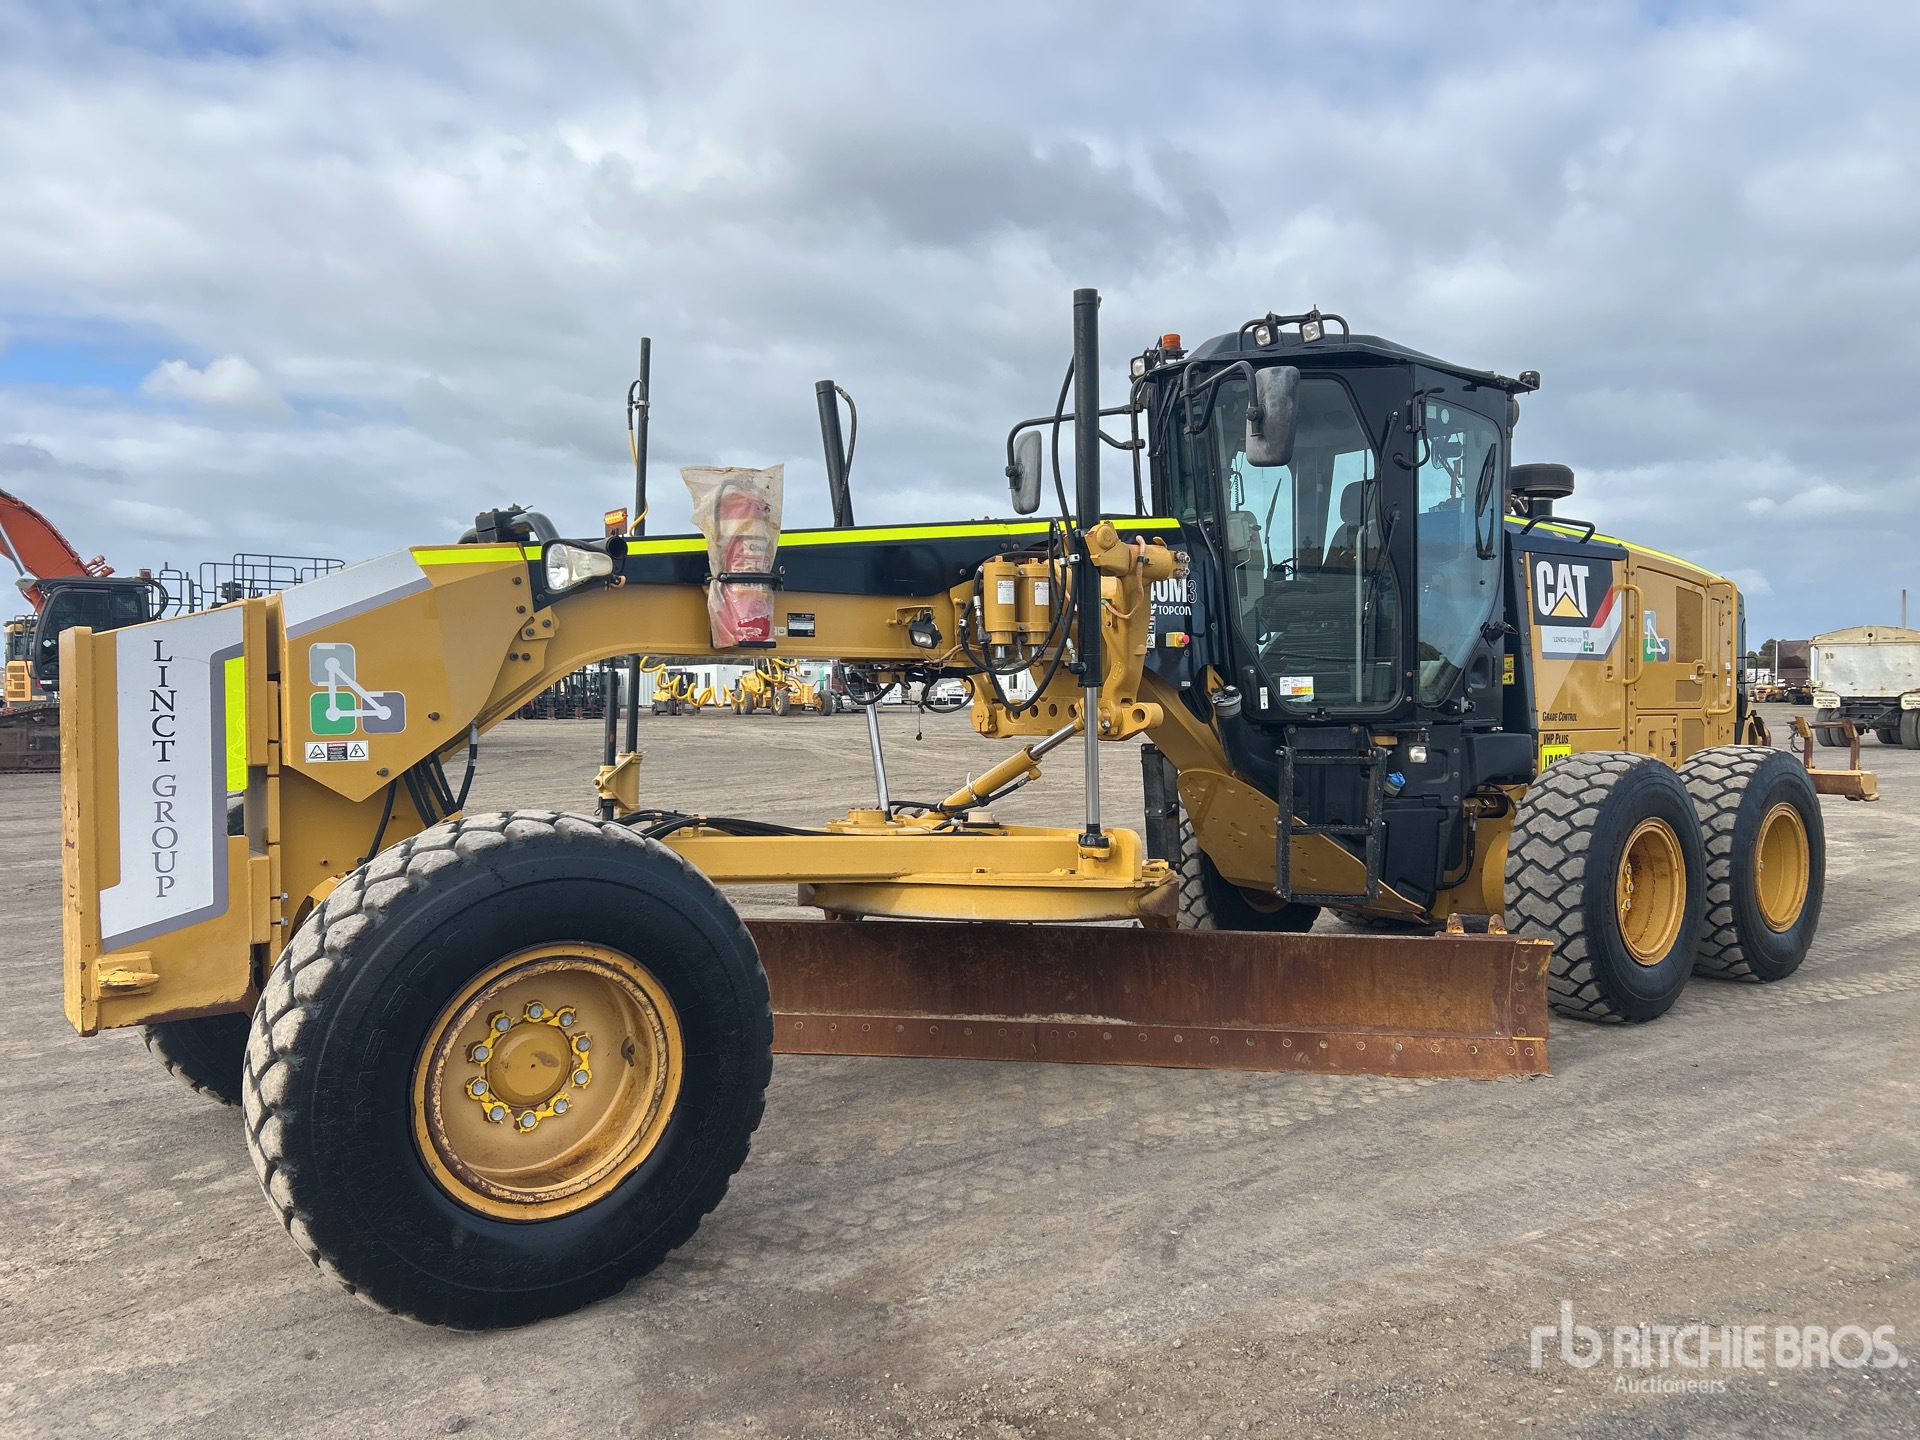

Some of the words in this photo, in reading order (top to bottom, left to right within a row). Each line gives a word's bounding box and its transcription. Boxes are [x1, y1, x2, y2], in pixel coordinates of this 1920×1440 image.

[1536, 560, 1589, 618] CAT
[1157, 605, 1192, 616] TOPCON
[149, 639, 178, 763] LINCT
[1542, 711, 1558, 721] GRADE
[1558, 711, 1577, 721] CONTROL
[1543, 733, 1555, 745] VHP
[1555, 733, 1569, 744] PLUS
[151, 774, 178, 898] GROUP
